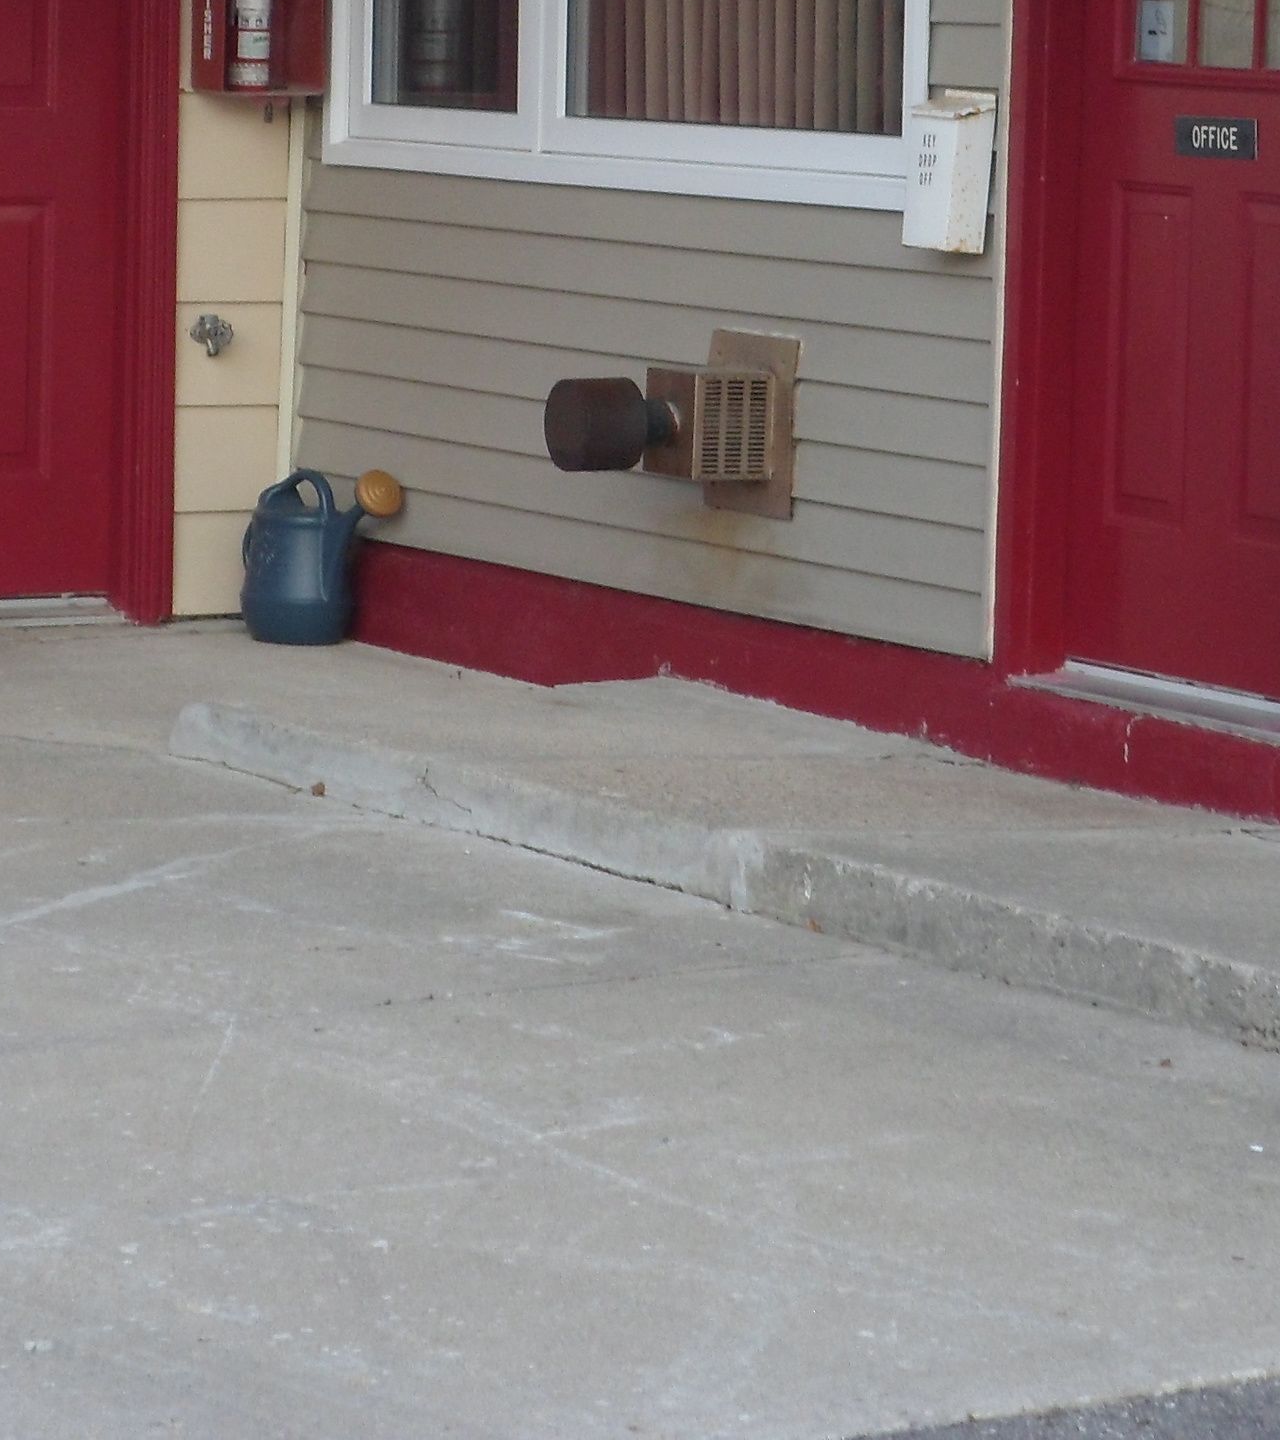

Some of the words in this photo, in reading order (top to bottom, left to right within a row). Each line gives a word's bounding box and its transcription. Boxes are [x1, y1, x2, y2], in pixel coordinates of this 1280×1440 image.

[922, 133, 937, 148] KEY
[1192, 124, 1239, 151] OFFICE
[918, 153, 938, 168] DROP
[919, 171, 933, 186] OFF
